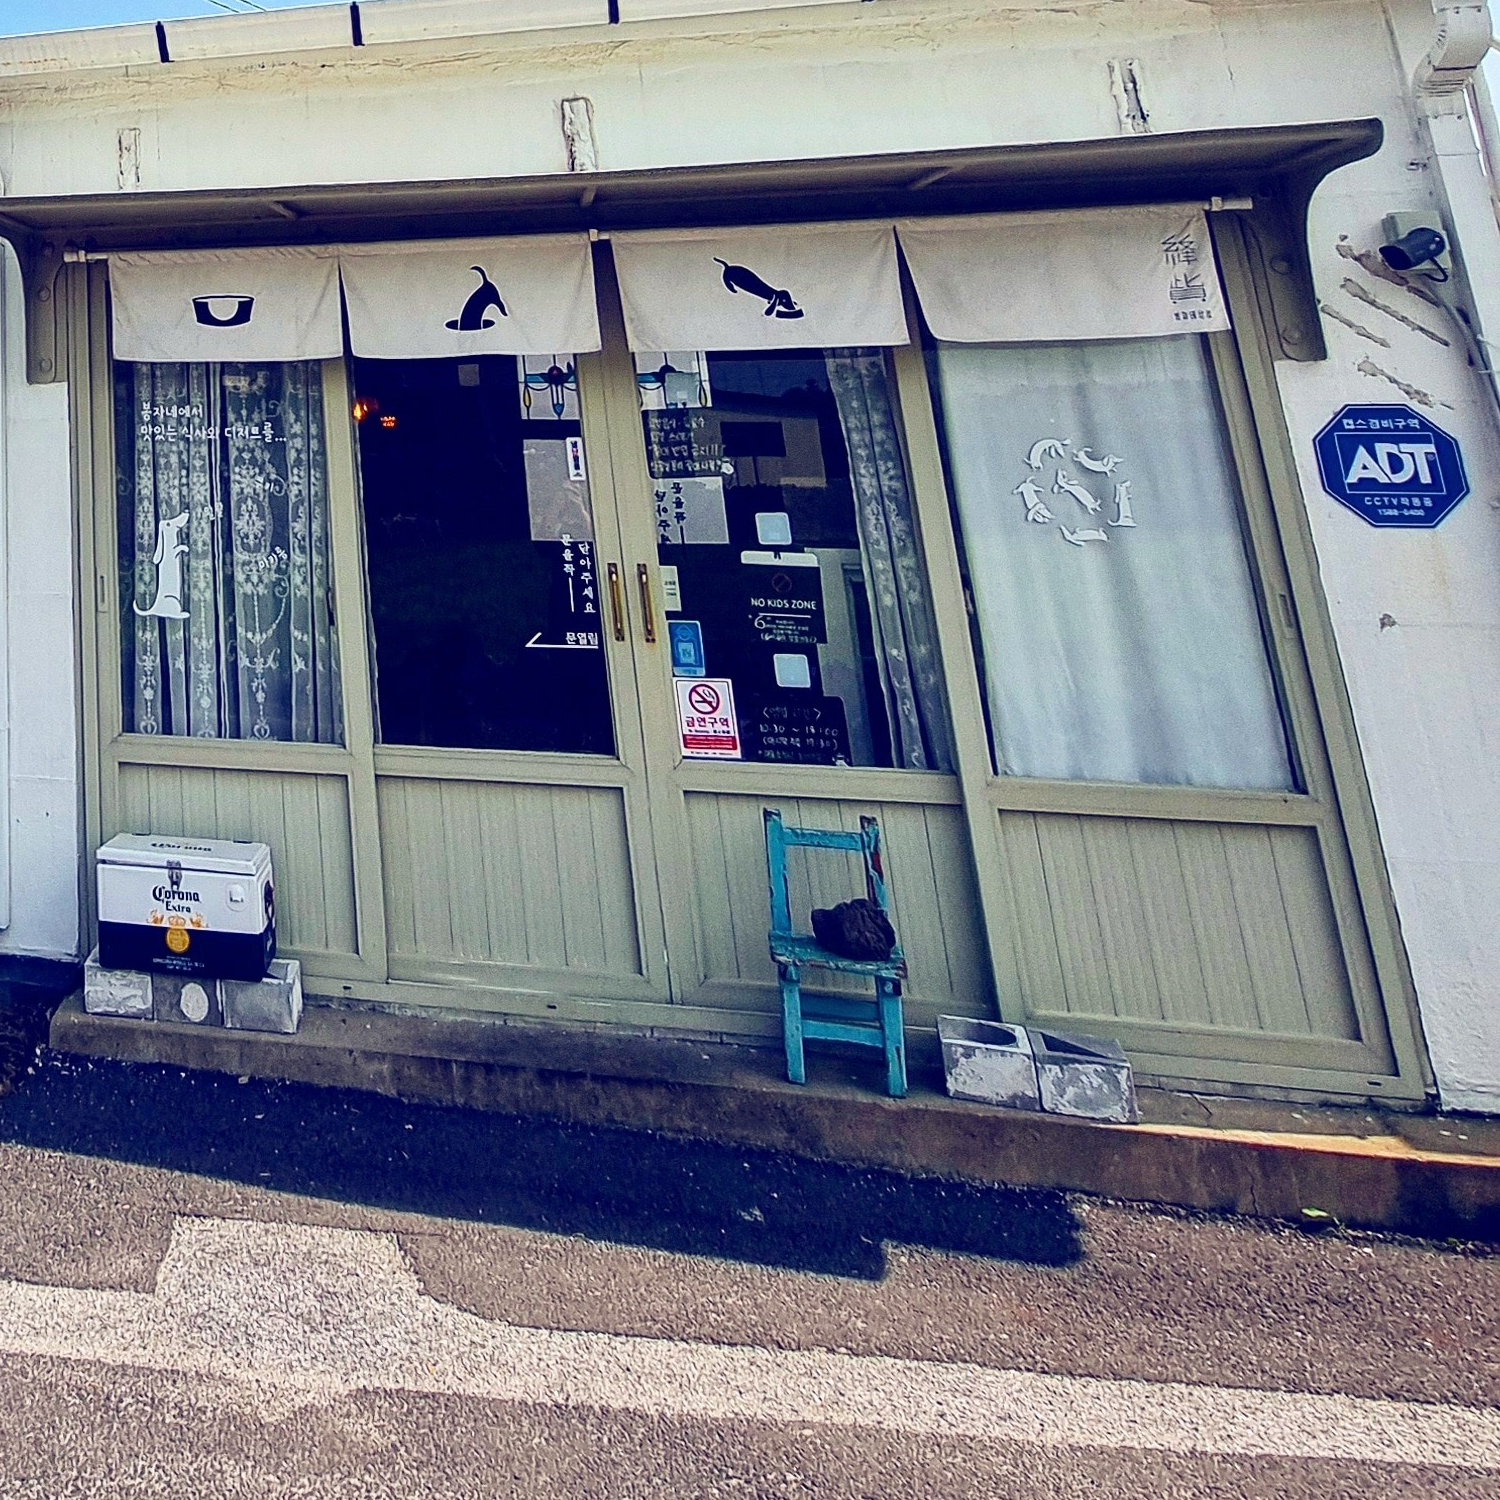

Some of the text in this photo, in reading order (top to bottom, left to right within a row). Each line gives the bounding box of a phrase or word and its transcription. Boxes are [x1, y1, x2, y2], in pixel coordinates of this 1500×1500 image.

[141, 401, 203, 421] 봉자네에서
[1342, 418, 1421, 430] 캡스경비구역
[140, 425, 178, 443] 맛있는
[181, 426, 221, 442] 식사와
[1345, 442, 1437, 484] ADT
[751, 598, 817, 610] NO KIDS ZONE
[685, 716, 730, 729] 금연구역
[152, 884, 201, 904] Corona
[165, 900, 191, 913] Extra
